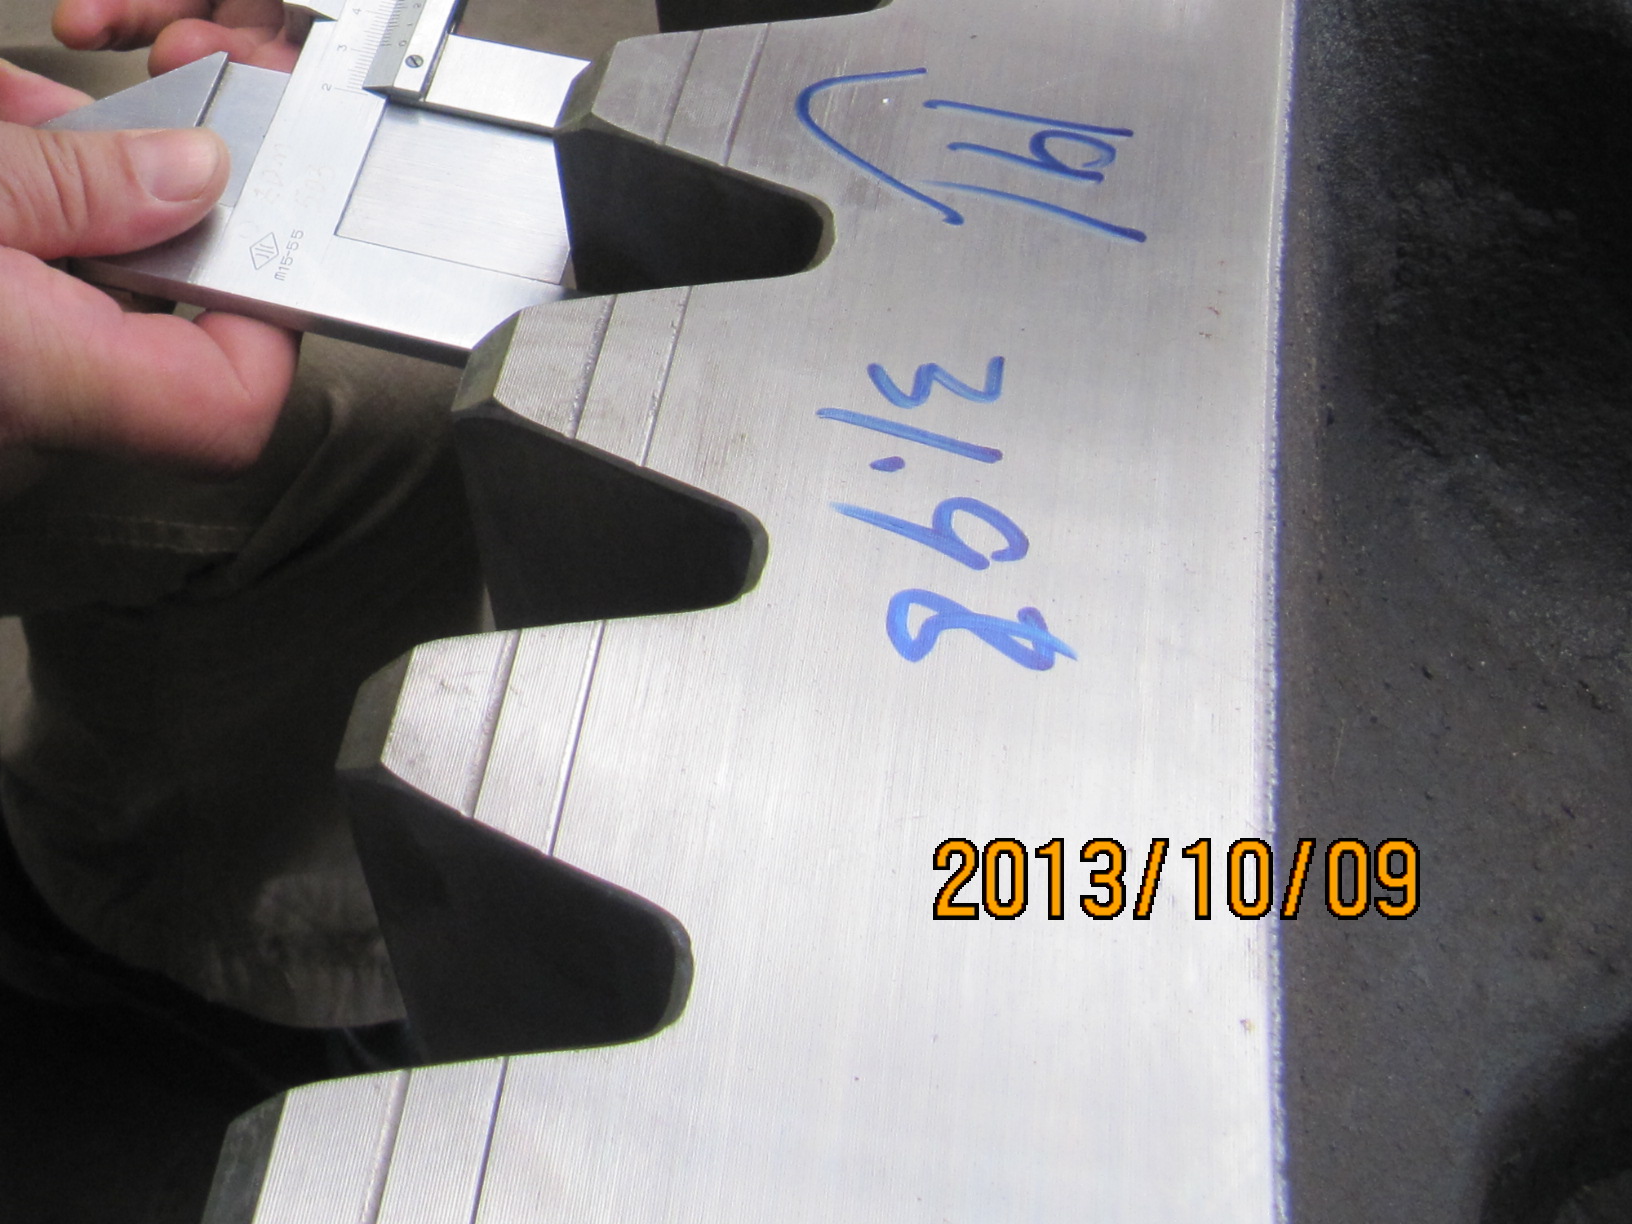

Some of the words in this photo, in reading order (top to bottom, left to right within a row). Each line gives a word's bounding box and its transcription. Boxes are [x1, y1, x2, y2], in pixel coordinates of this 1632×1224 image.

[920, 99, 1148, 242] 191
[273, 228, 304, 281] m15-55
[816, 357, 1078, 670] 31.98
